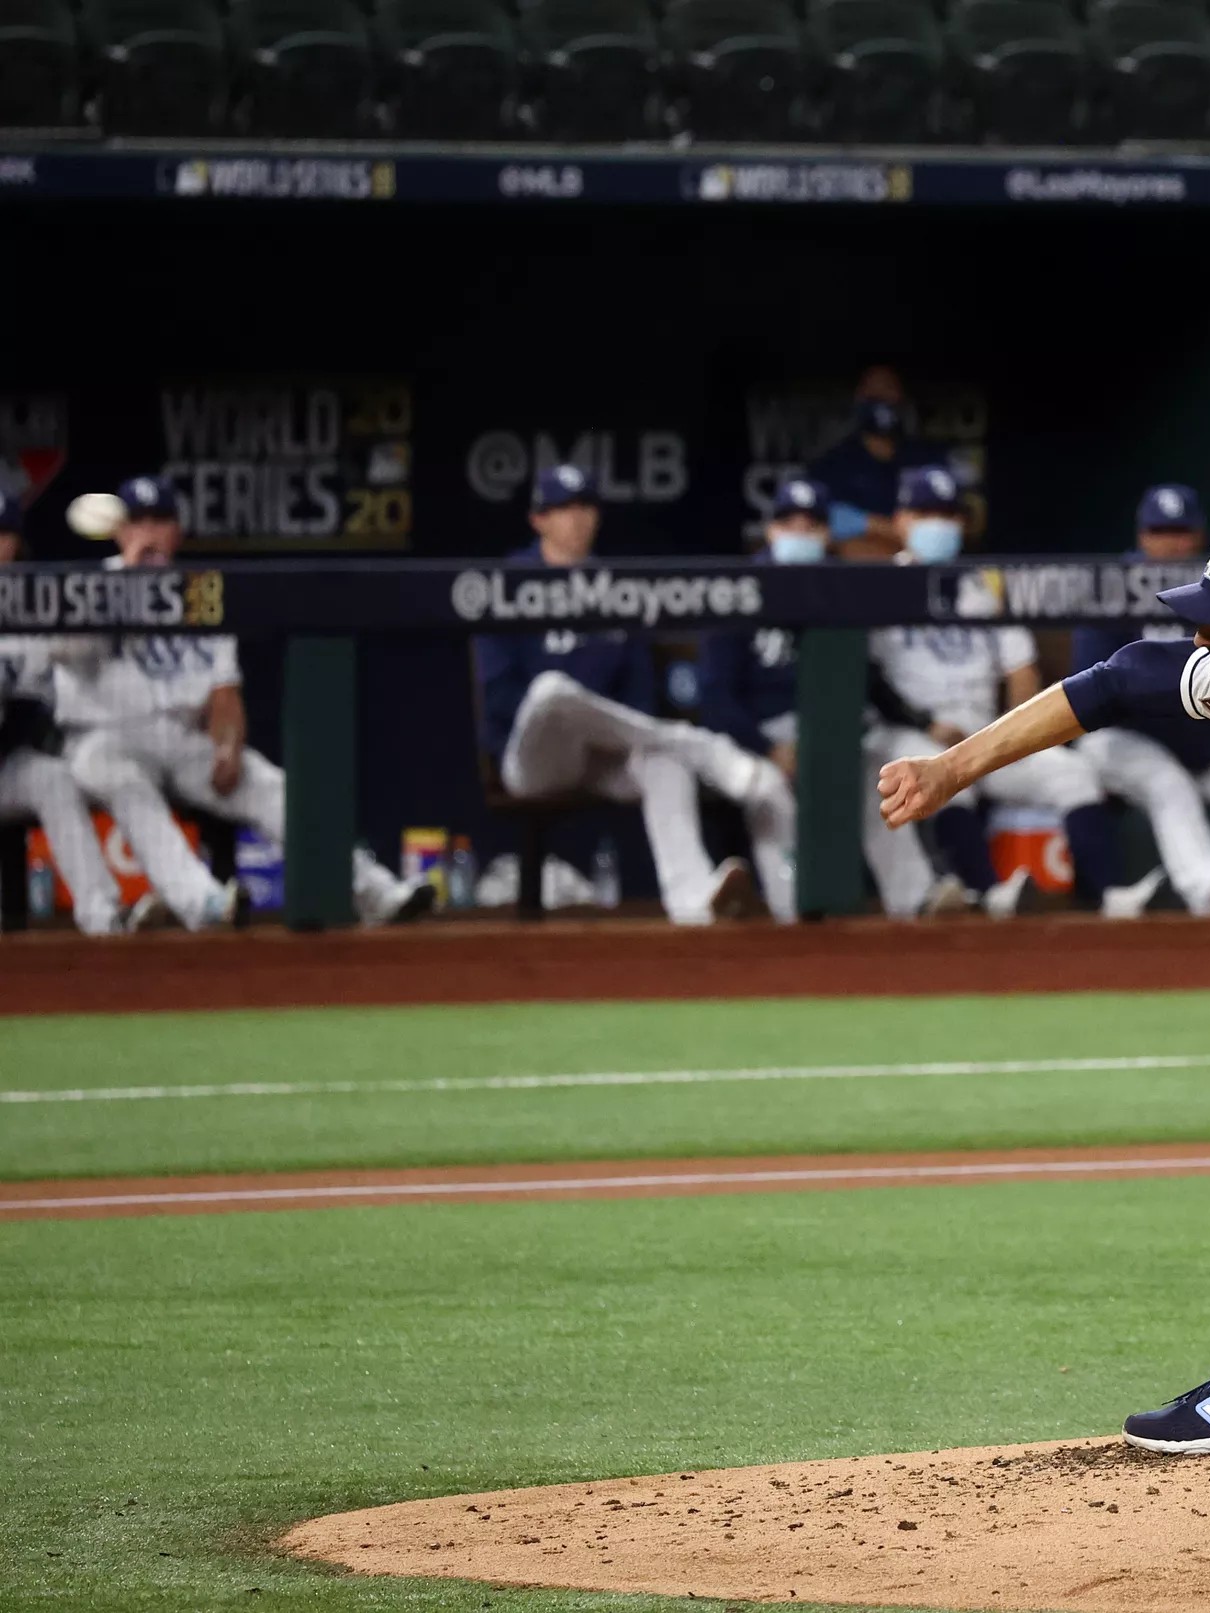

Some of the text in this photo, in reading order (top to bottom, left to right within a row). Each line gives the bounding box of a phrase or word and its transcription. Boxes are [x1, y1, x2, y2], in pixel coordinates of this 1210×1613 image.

[160, 389, 341, 456] WORLD
[344, 487, 411, 534] 20
[63, 571, 184, 627] SERIES
[451, 567, 762, 626] @LasMayores
[1007, 564, 1128, 620] WORLD
